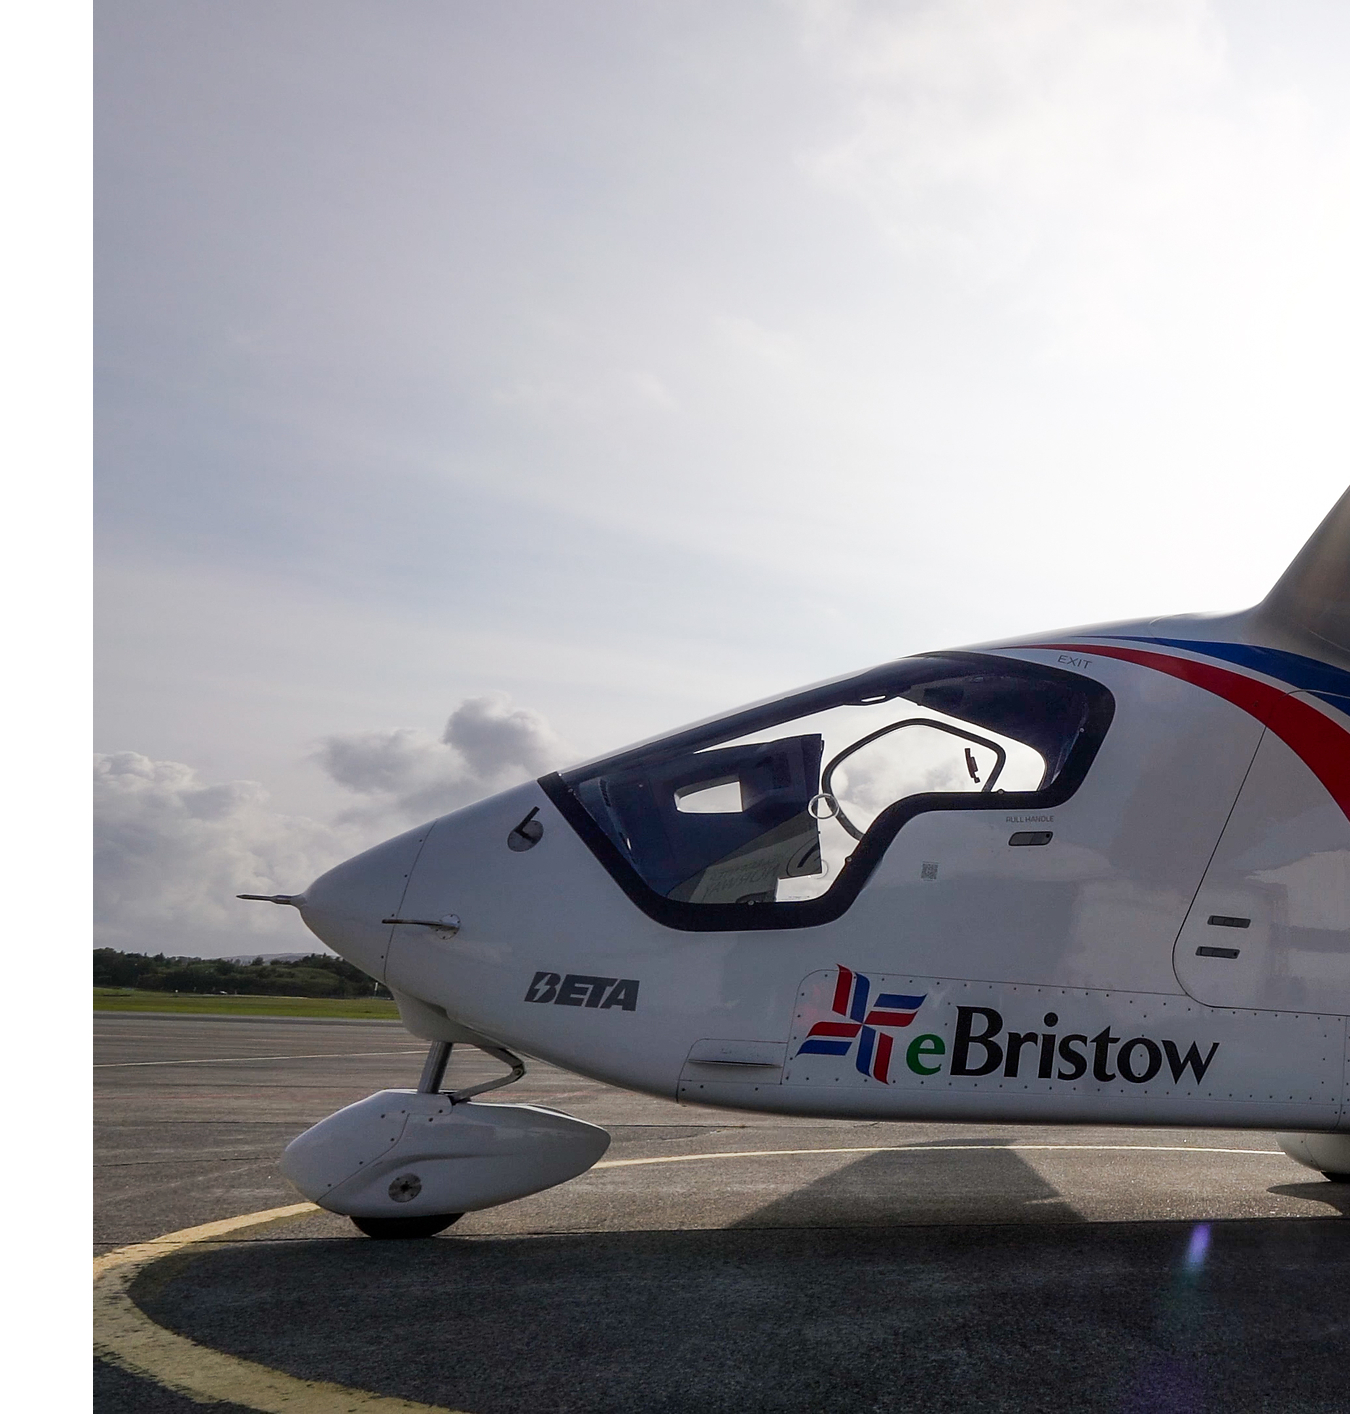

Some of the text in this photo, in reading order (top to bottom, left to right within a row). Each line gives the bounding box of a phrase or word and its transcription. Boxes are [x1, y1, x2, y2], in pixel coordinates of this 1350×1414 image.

[1058, 655, 1092, 669] EXIT
[1025, 815, 1055, 823] HANDLE
[524, 971, 640, 1011] BETA
[906, 1005, 1220, 1085] eBristow
